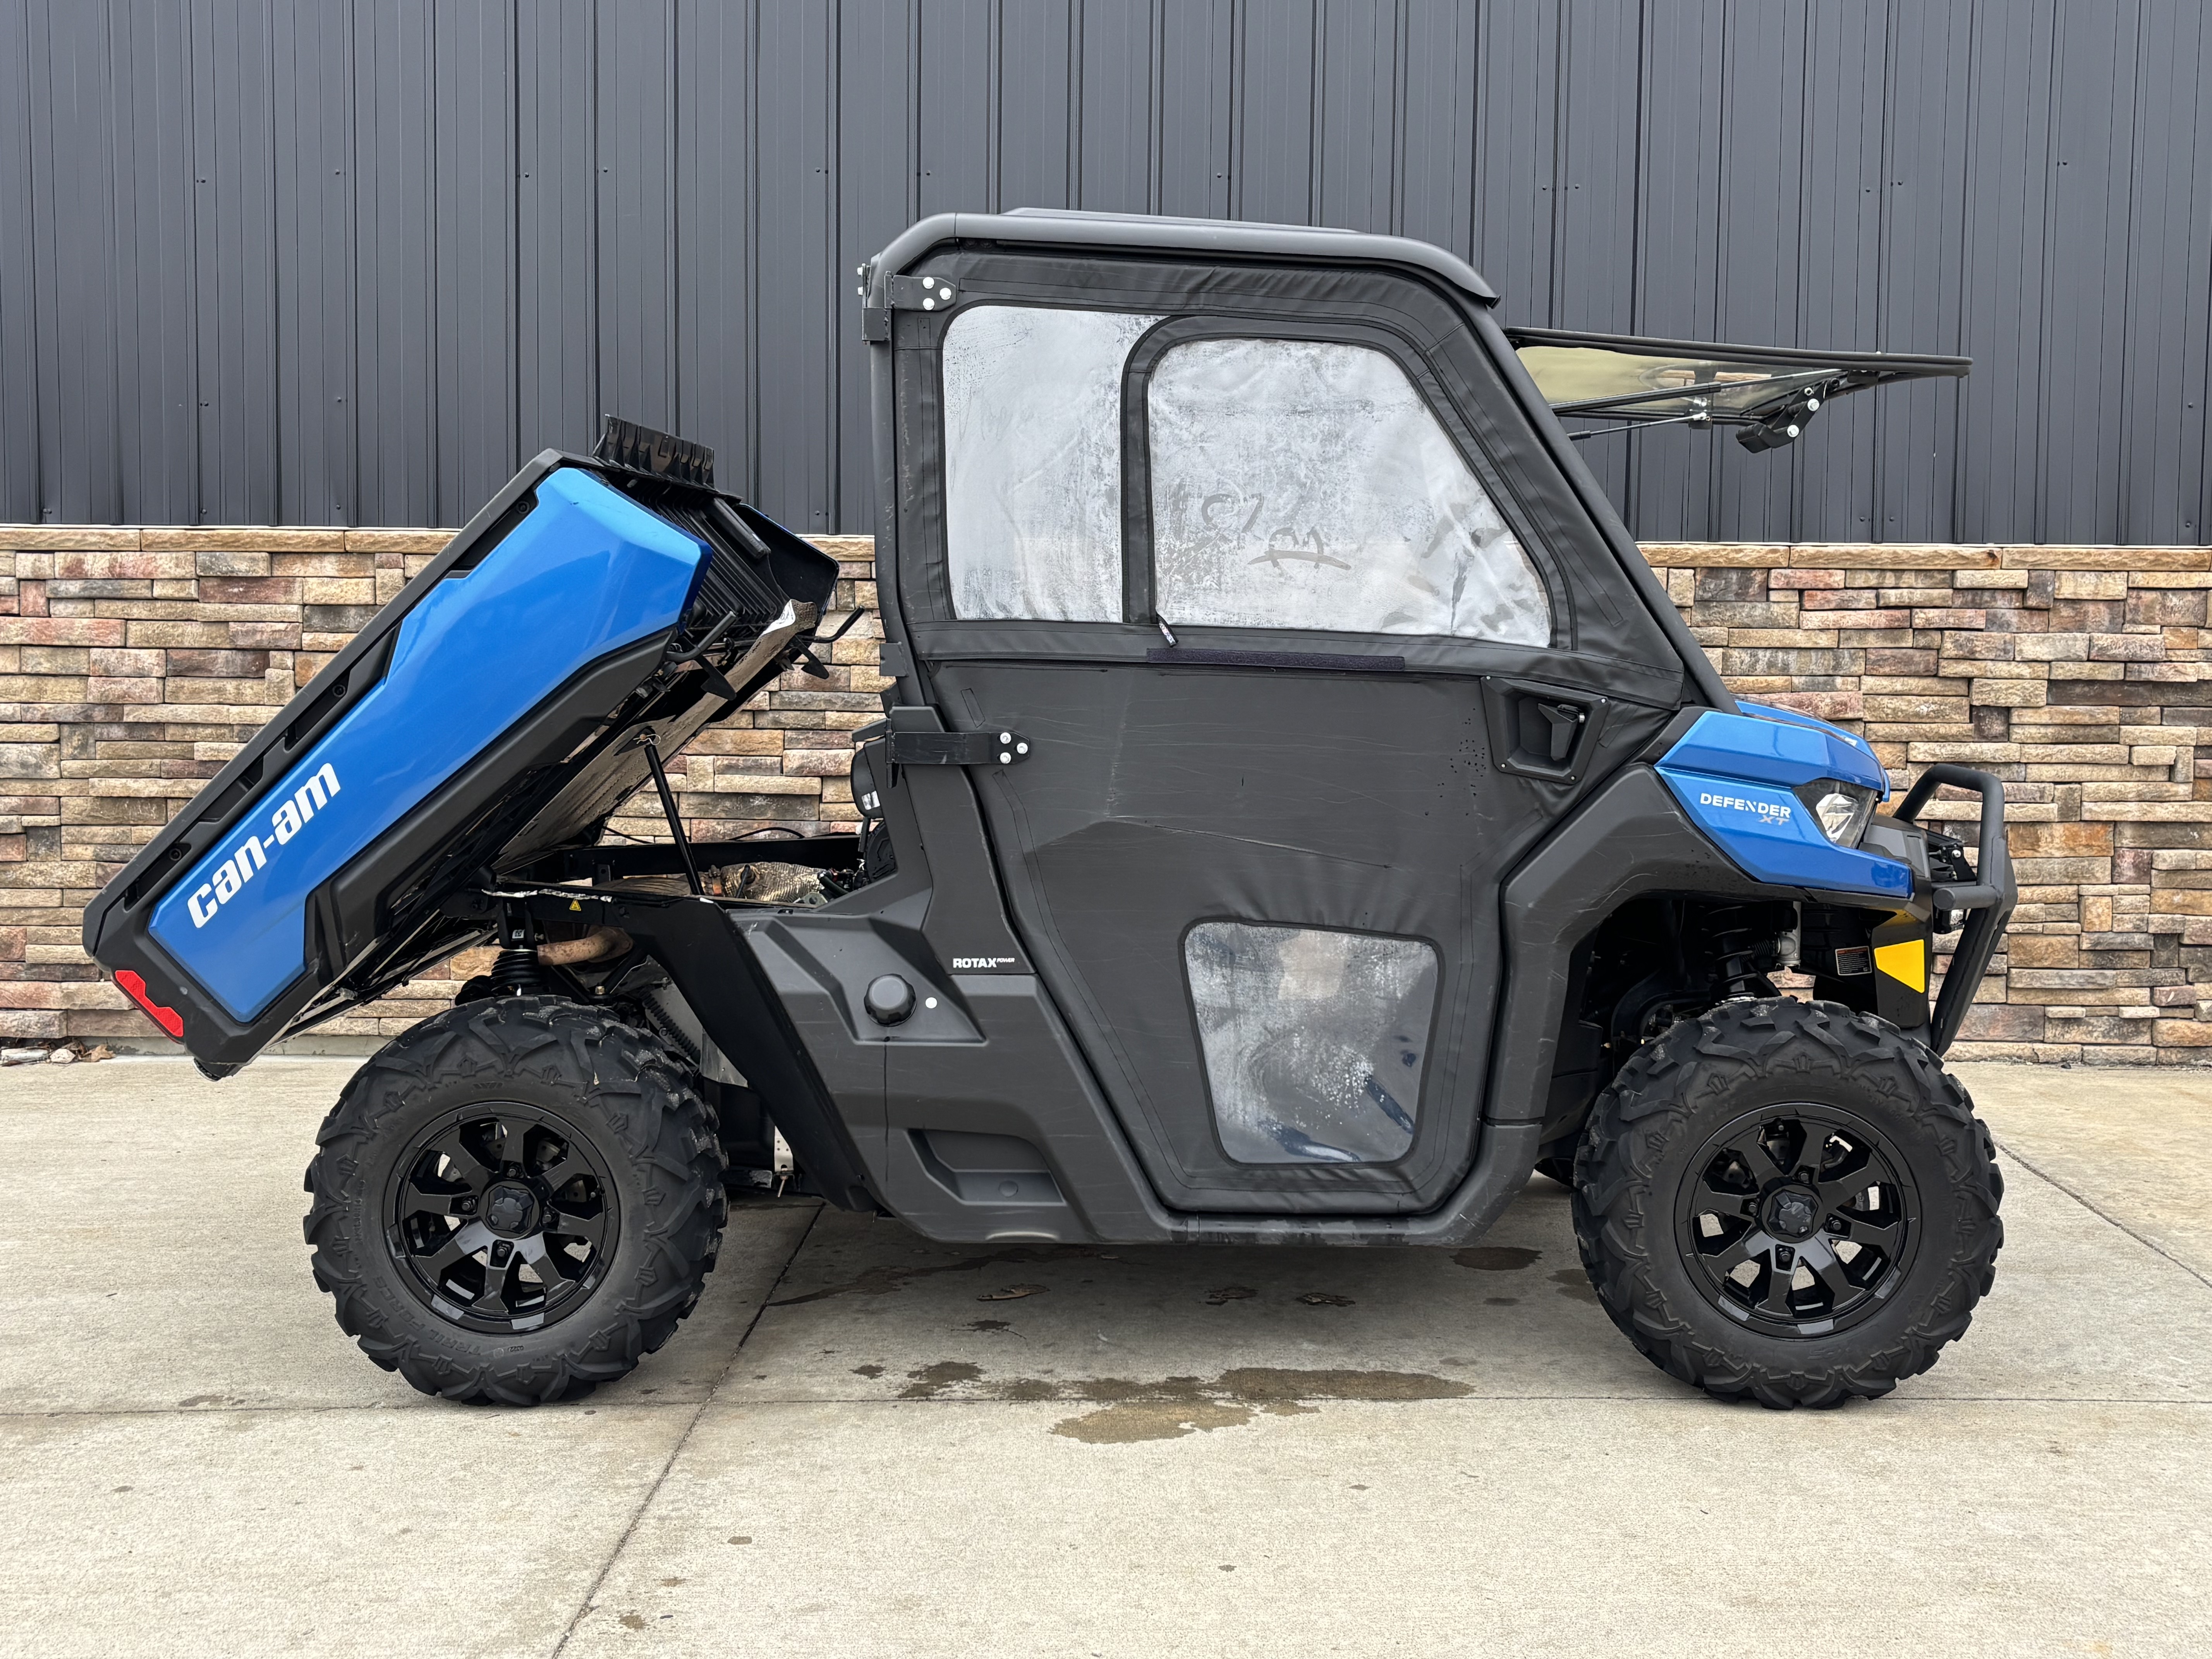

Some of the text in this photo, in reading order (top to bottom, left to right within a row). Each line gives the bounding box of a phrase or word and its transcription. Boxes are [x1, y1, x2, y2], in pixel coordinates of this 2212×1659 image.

[1700, 793, 1791, 818] DEFENDER
[1758, 815, 1790, 825] XT
[187, 763, 341, 928] can-am
[953, 958, 997, 968] ROTAX
